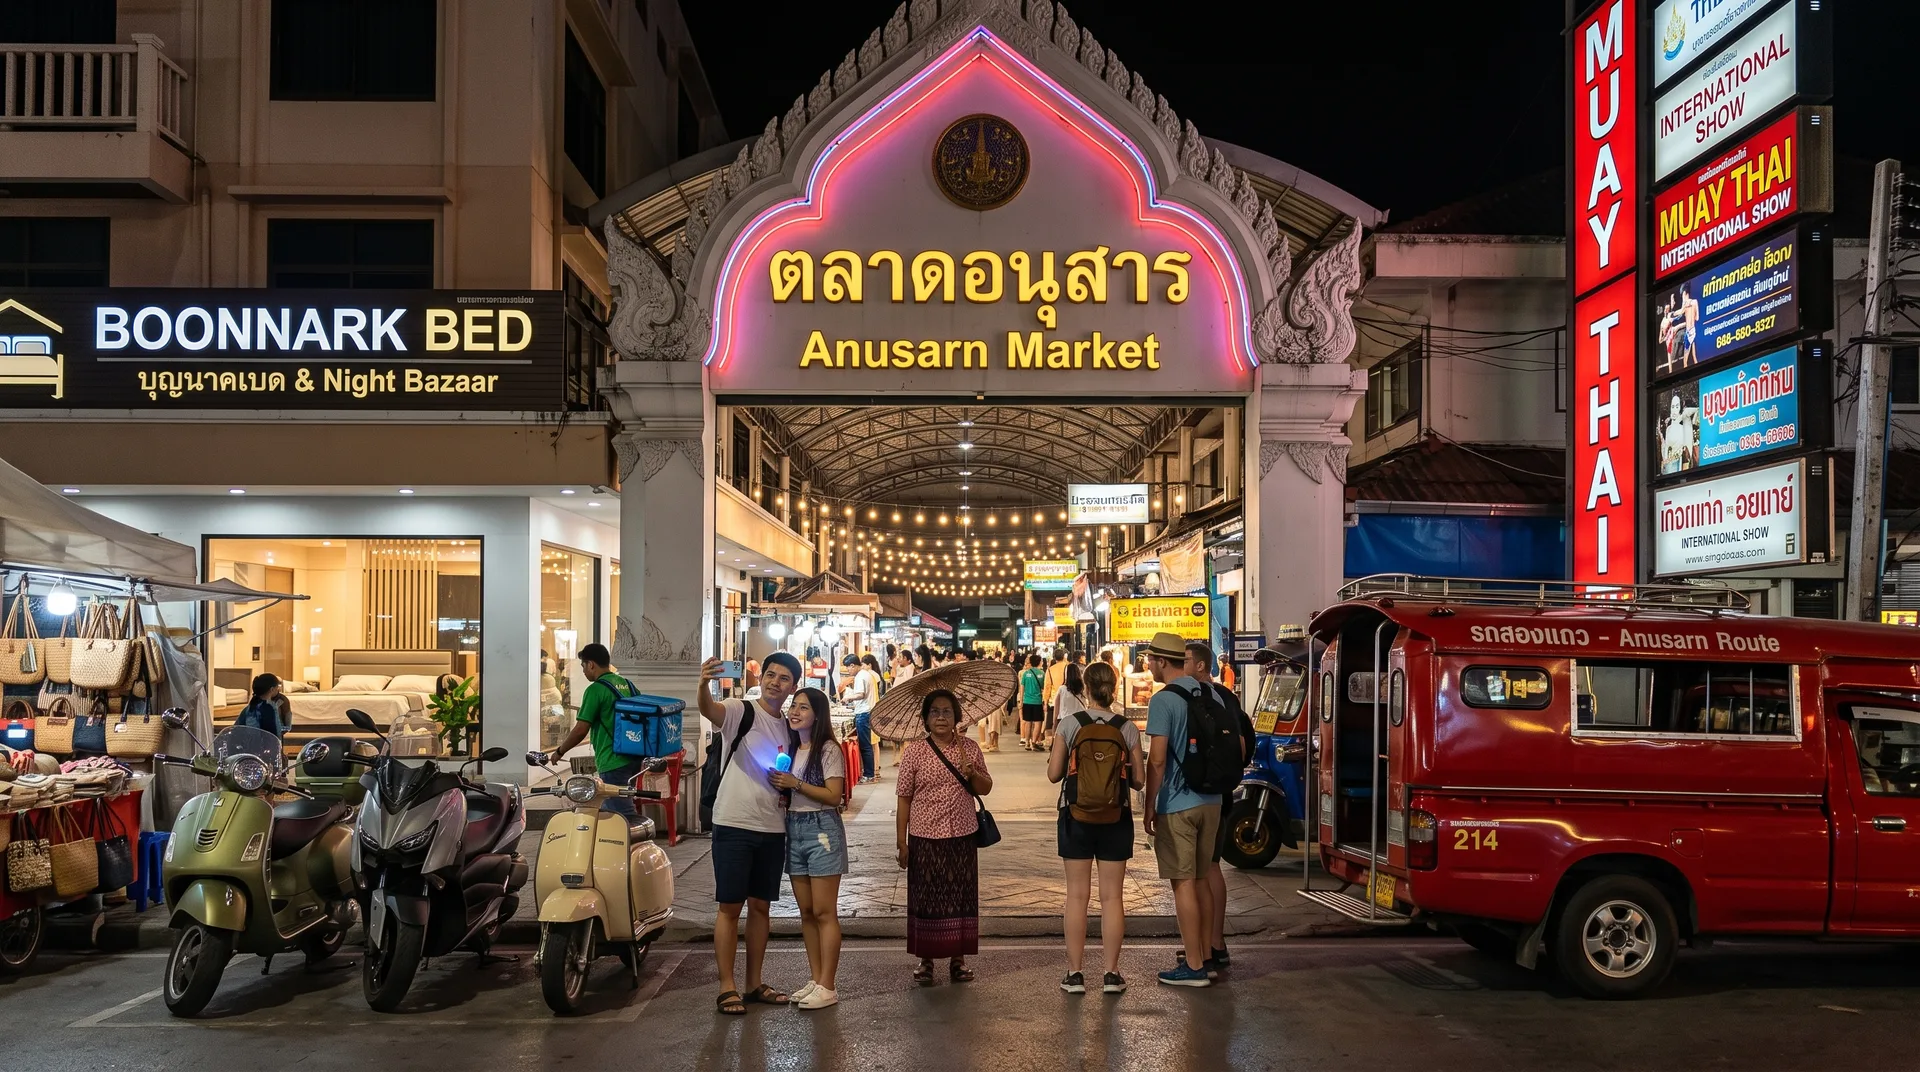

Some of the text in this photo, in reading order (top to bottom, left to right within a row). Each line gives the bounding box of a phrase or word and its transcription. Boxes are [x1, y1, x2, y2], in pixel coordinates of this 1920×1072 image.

[1660, 33, 1790, 139] INTERNATIONAL
[1585, 0, 1623, 269] MUAY
[1695, 92, 1746, 144] SHOW
[1660, 176, 1726, 248] MUAY
[1730, 136, 1793, 207] THAI
[1660, 187, 1792, 271] INTERNATIONAL SHOW
[768, 244, 1193, 329] ตลาดอนุสาร
[95, 306, 534, 353] BOONNARK BED
[798, 331, 1161, 370] Anusarn Market
[138, 369, 499, 400] บุญนาคเบด & Night Bazaar
[1586, 310, 1622, 574] THAI
[1681, 526, 1770, 549] INTERNATIONAL SHOW
[1470, 625, 1590, 646] รถสองแถว
[1619, 628, 1709, 650] Anusarn
[1715, 631, 1781, 653] Route
[1453, 828, 1499, 851] 214
